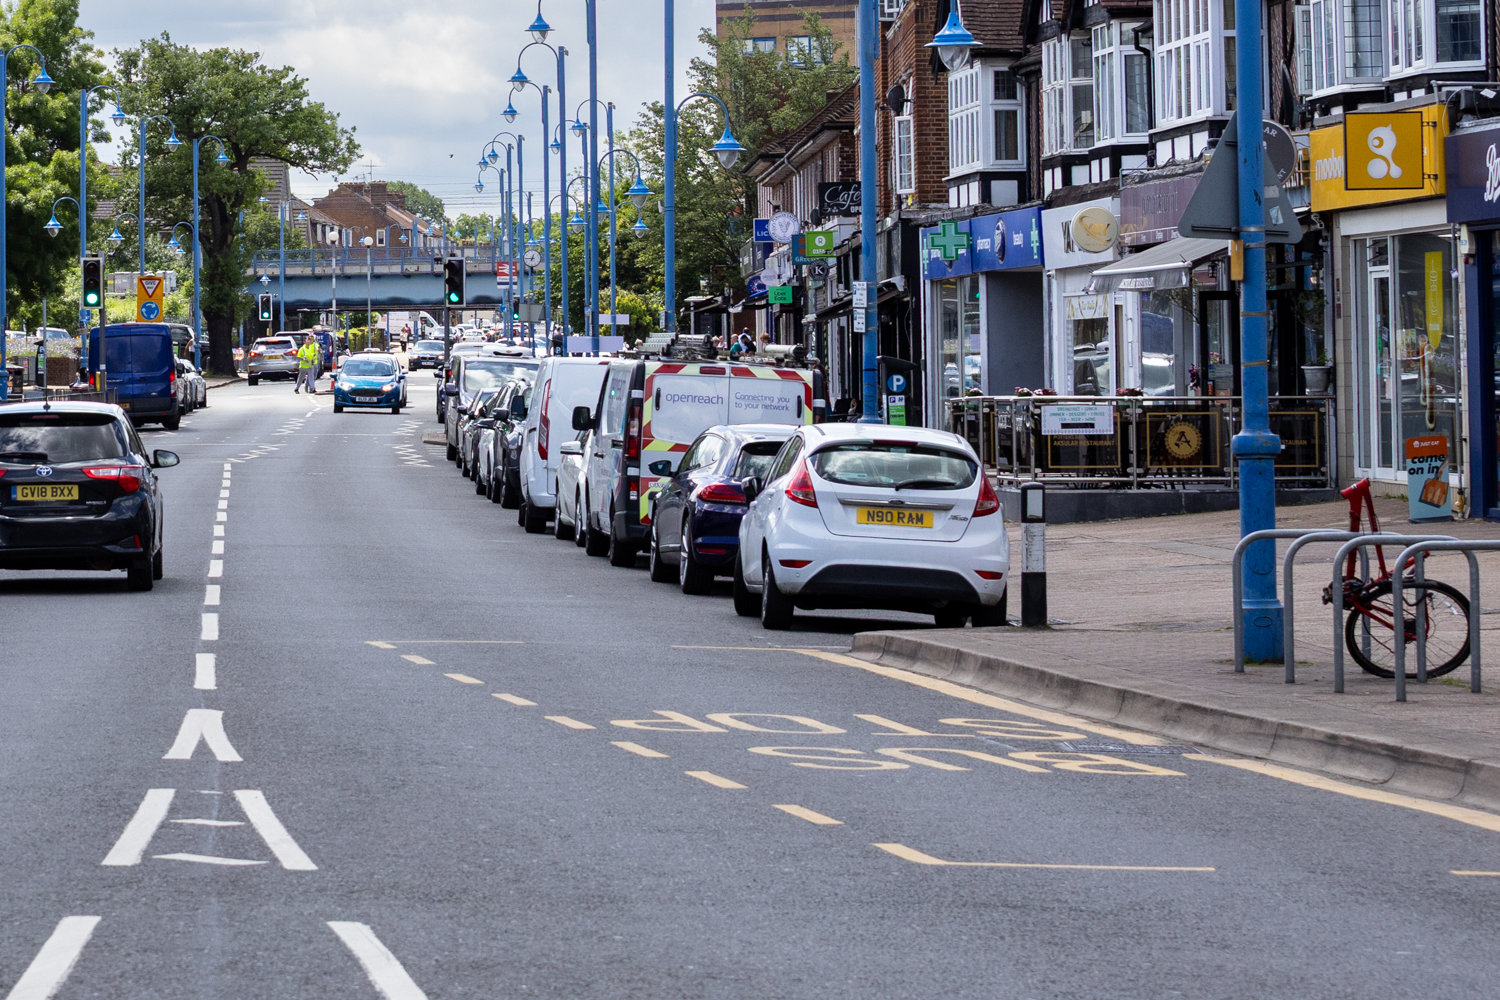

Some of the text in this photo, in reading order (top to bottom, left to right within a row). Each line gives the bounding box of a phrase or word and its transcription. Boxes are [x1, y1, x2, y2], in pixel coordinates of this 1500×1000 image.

[1315, 148, 1344, 182] moobo
[893, 374, 904, 392] P
[665, 393, 724, 405] openreach
[734, 391, 790, 404] Connecting you
[744, 403, 759, 411] your
[761, 403, 790, 411] network
[1411, 454, 1446, 464] come
[1408, 463, 1440, 475] on in
[21, 486, 73, 498] GV18 BXX
[867, 510, 924, 525] N90 RAM
[609, 710, 1087, 740] STOP
[747, 746, 1188, 776] BUS
